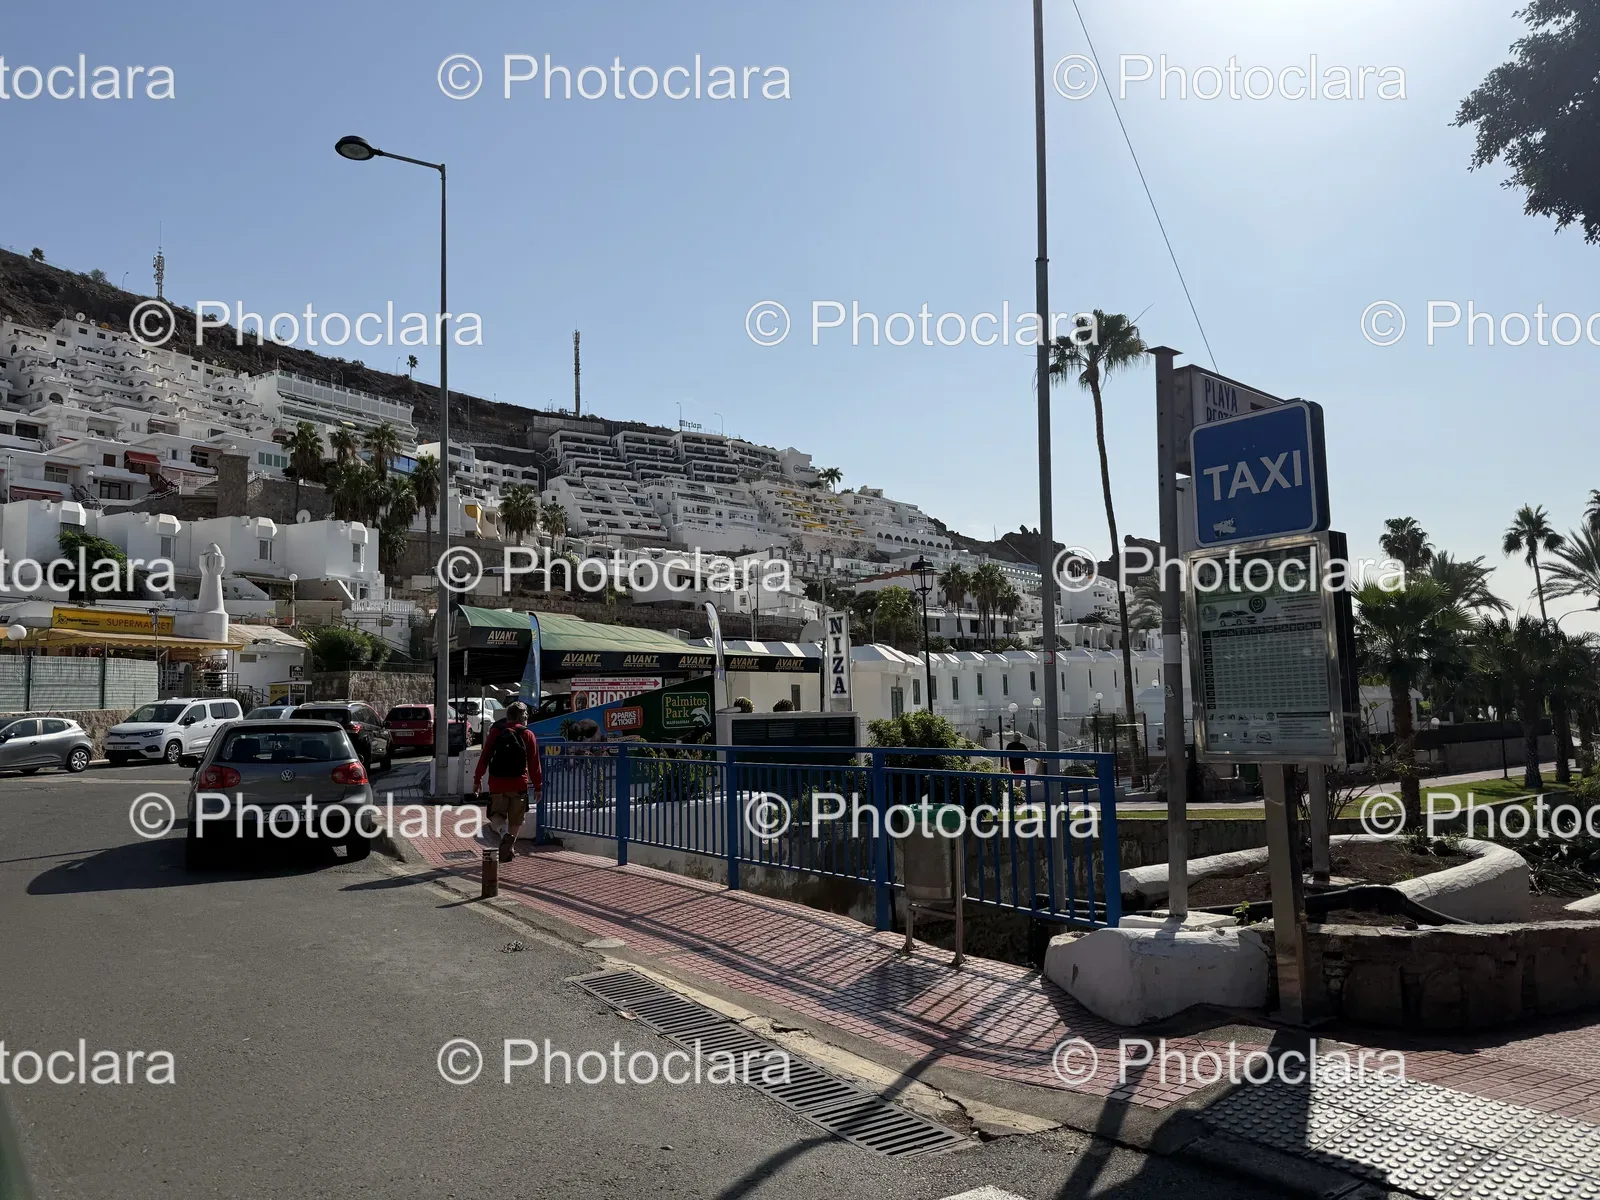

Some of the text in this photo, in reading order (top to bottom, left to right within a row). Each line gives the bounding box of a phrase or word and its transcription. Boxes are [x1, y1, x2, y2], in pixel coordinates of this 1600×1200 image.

[1204, 379, 1238, 413] PLAYA
[1203, 450, 1302, 501] TAXI
[487, 630, 518, 641] AVANT
[562, 653, 601, 663] AVANT
[624, 654, 659, 663] AVANT
[679, 655, 711, 664] AVANT
[829, 616, 847, 694] NIZA
[729, 657, 759, 666] AVANT
[775, 658, 804, 667] AVANT
[665, 695, 707, 707] Palmitos
[610, 712, 618, 727] 2
[616, 710, 636, 719] PARKS
[665, 707, 690, 719] Park
[617, 717, 636, 726] TICKET
